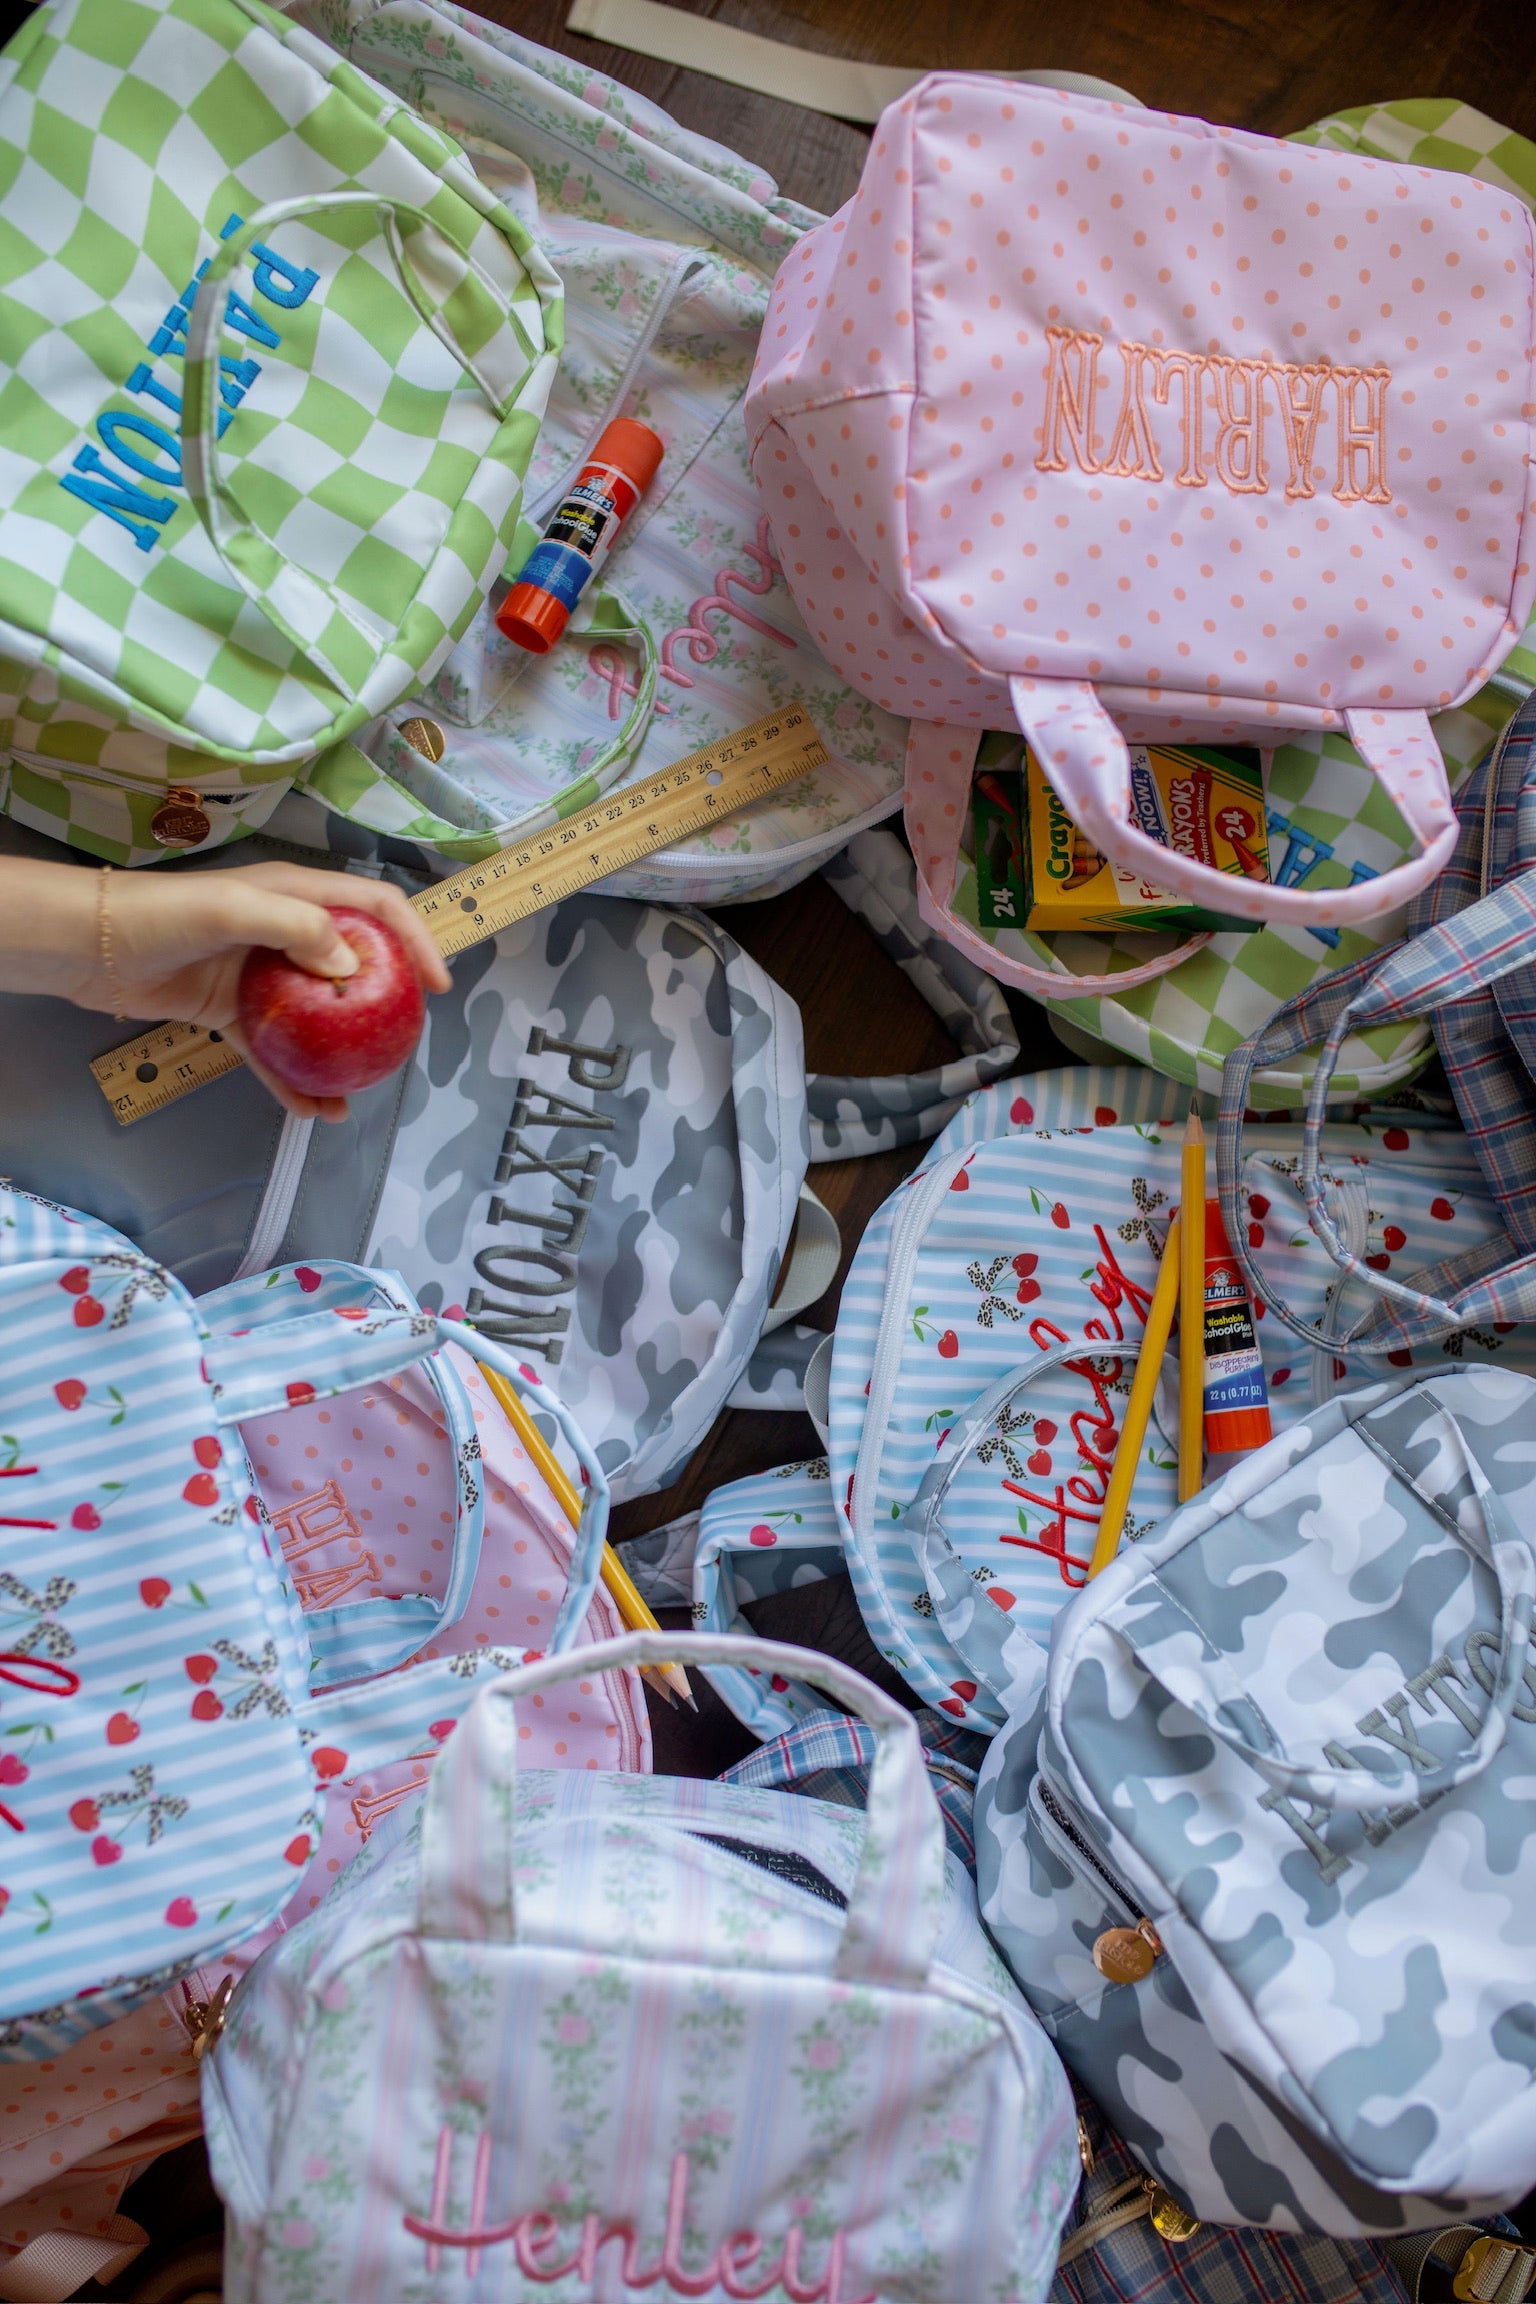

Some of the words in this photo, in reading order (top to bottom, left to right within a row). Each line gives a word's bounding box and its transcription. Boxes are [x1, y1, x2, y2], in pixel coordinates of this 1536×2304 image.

[1034, 324, 1393, 505] HARLYN
[572, 487, 614, 510] ELMER'S
[762, 765, 772, 777] 1
[704, 794, 716, 806] 2
[1133, 772, 1160, 830] NOW!
[1196, 782, 1206, 817] Teachers!
[423, 901, 439, 915] 14
[447, 889, 462, 902] 15
[469, 876, 485, 890] 16
[492, 865, 507, 879] 17
[515, 853, 531, 867] 18
[538, 841, 554, 855] 19
[560, 829, 577, 844] 20
[584, 818, 600, 832] 21
[606, 806, 623, 821] 22
[629, 795, 645, 809] 23
[651, 784, 668, 798] 24
[674, 772, 691, 786] 25
[696, 760, 713, 774] 26
[719, 748, 736, 763] 27
[741, 737, 757, 752] 28
[763, 726, 780, 740] 29
[785, 714, 803, 729] 30
[1170, 779, 1199, 862] RAYONS
[1198, 817, 1207, 828] by
[1222, 811, 1246, 838] 24
[648, 823, 659, 836] 3
[1042, 785, 1075, 879] Crayol
[1198, 828, 1211, 865] Preferred
[589, 854, 600, 865] 4
[532, 883, 543, 895] 5
[989, 887, 1016, 918] 24
[474, 913, 484, 925] 6
[102, 1072, 114, 1081] cm
[118, 1062, 126, 1072] 1
[141, 1049, 150, 1059] 2
[165, 1036, 174, 1047] 3
[189, 1024, 198, 1034] 4
[177, 1063, 194, 1078] 11
[115, 1094, 134, 1111] 12
[466, 1025, 632, 1365] PAXTON
[1204, 1286, 1246, 1299] ELMER'S
[1206, 1313, 1245, 1328] Washable
[1210, 1390, 1220, 1401] 22
[1220, 1391, 1226, 1401] g
[1227, 1387, 1250, 1401] (0.77
[1257, 1610, 1536, 1887] PAXTO
[402, 2125, 878, 2304] Henley
